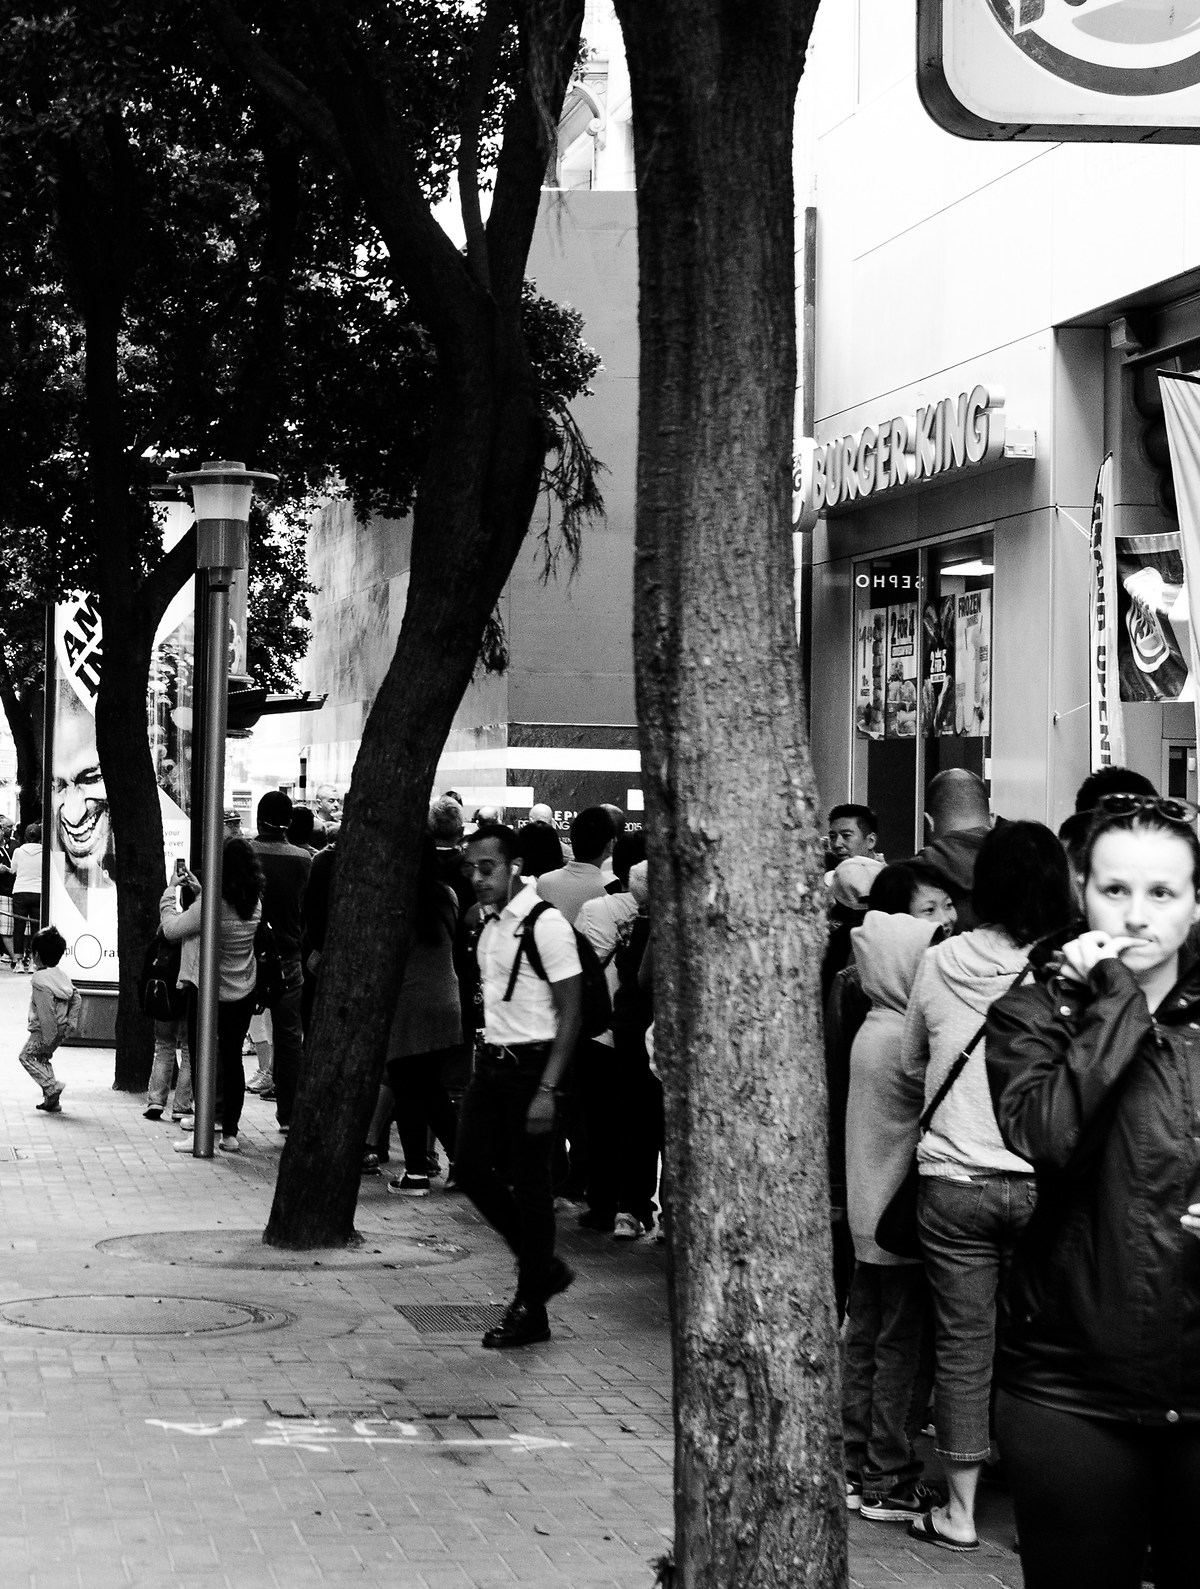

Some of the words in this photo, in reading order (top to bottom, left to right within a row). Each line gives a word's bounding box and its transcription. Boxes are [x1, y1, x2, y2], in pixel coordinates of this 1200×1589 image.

[813, 416, 909, 510] BURGER
[915, 384, 990, 479] KING
[958, 592, 982, 618] FROZEN
[890, 611, 897, 645] 2
[929, 651, 935, 674] 2
[942, 648, 947, 672] 5
[1097, 646, 1112, 765] OPENI
